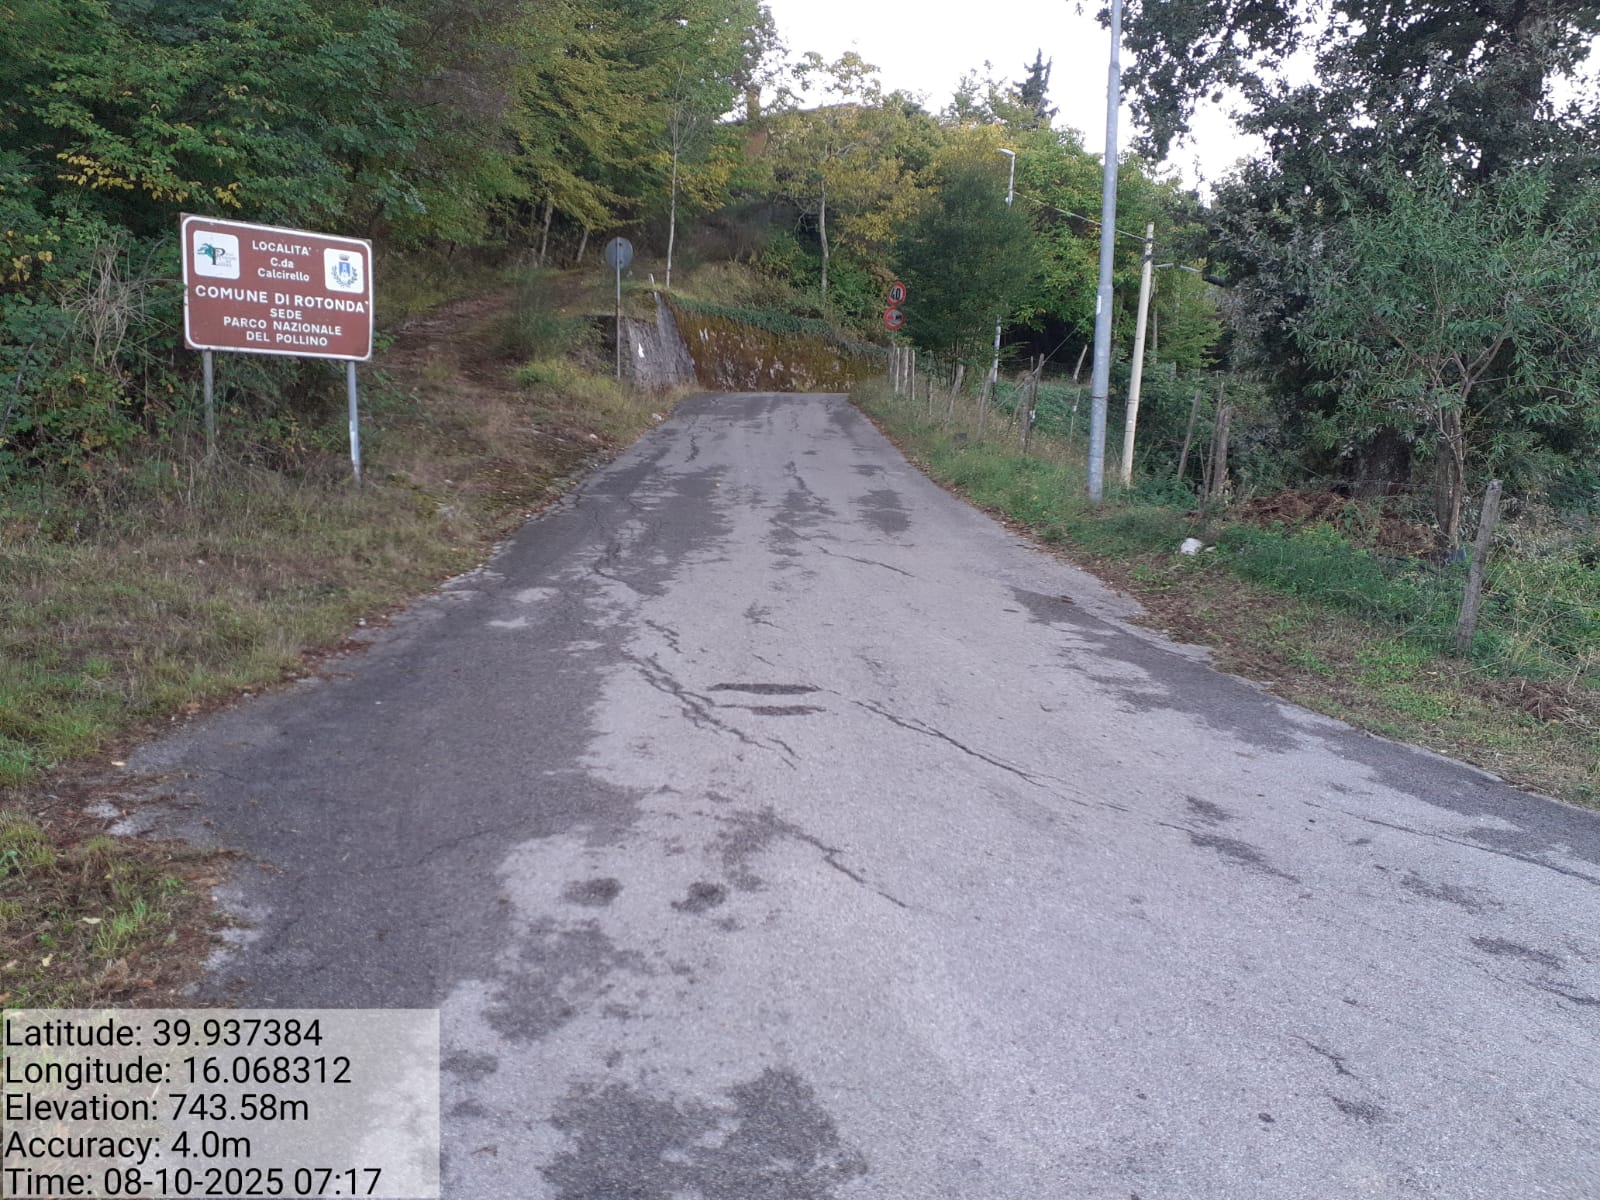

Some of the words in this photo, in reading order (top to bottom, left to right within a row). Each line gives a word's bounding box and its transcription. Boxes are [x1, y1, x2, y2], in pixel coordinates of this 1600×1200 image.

[270, 258, 294, 268] C.da
[258, 268, 309, 282] Calcirello
[195, 285, 268, 303] COMUNE
[275, 293, 289, 305] DI
[891, 288, 901, 300] 40
[270, 309, 302, 320] SEDE
[224, 317, 266, 329] PARCO
[273, 321, 342, 335] NAZIONALE
[247, 333, 270, 342] DEL
[276, 333, 328, 346] POLLINO
